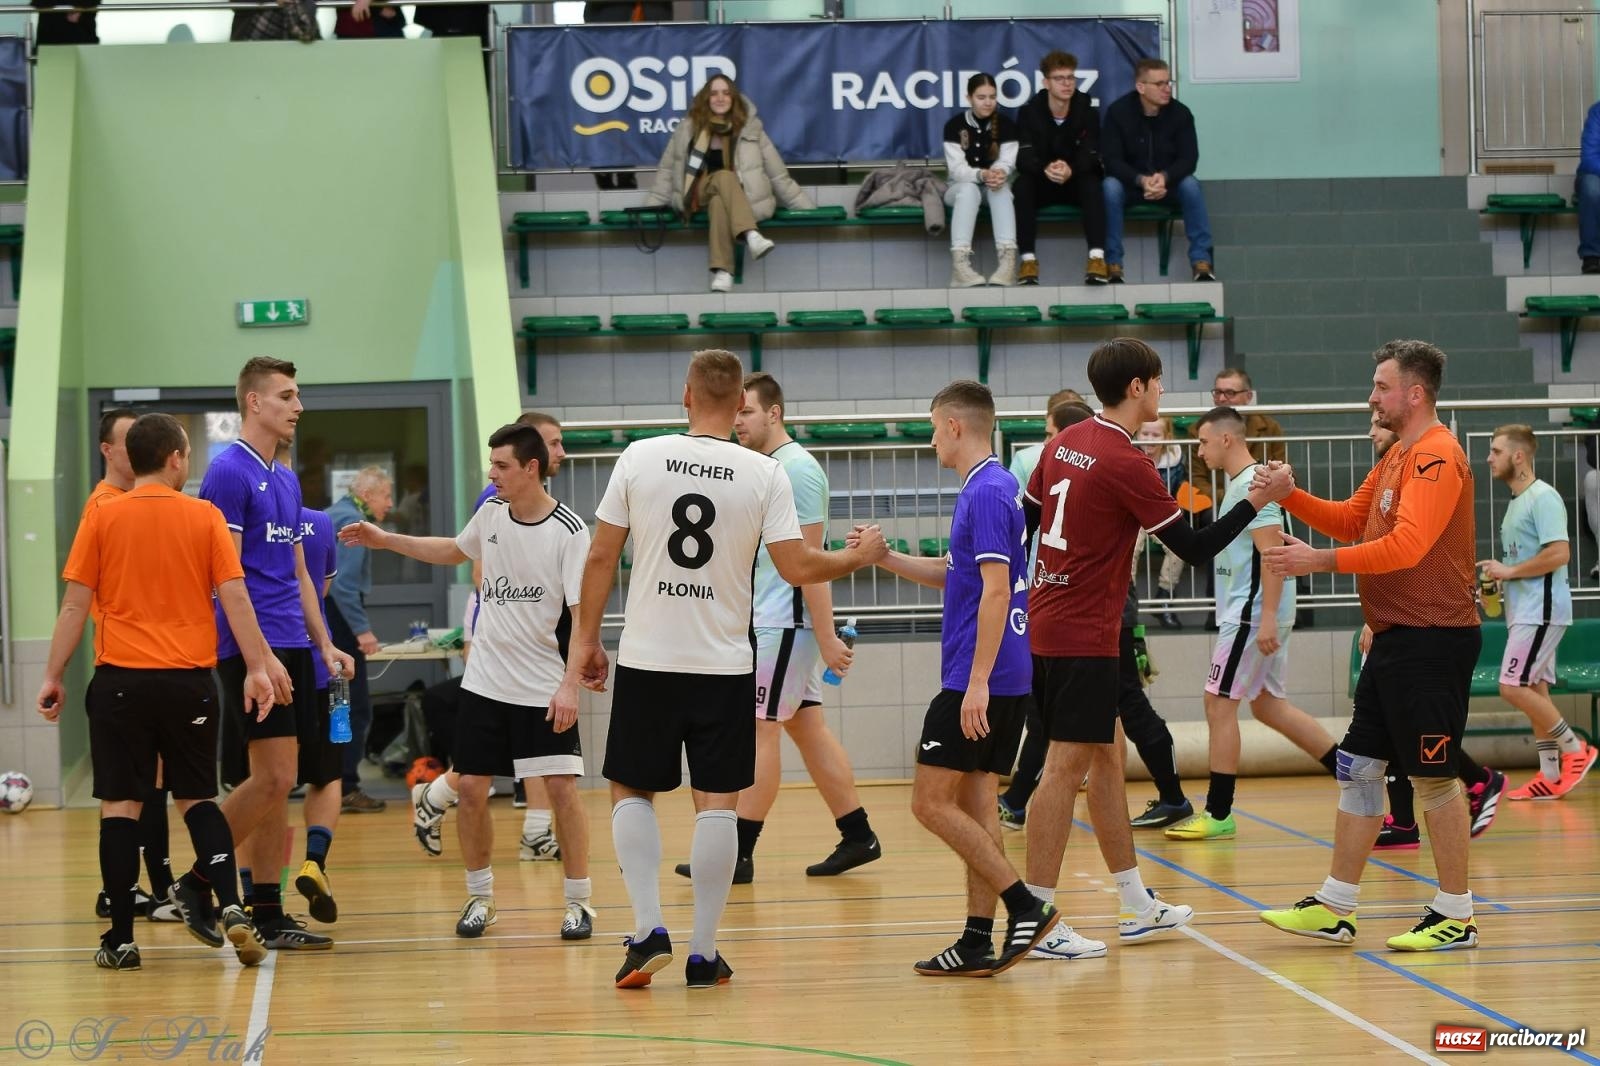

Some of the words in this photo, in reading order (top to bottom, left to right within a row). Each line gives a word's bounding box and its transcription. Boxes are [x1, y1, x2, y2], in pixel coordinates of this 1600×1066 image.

[665, 458, 735, 482] WICHER
[1054, 445, 1097, 471] BURDZY
[1041, 478, 1072, 551] 1
[667, 493, 716, 570] 8
[658, 581, 714, 600] PŁONIA
[1508, 657, 1518, 674] 2
